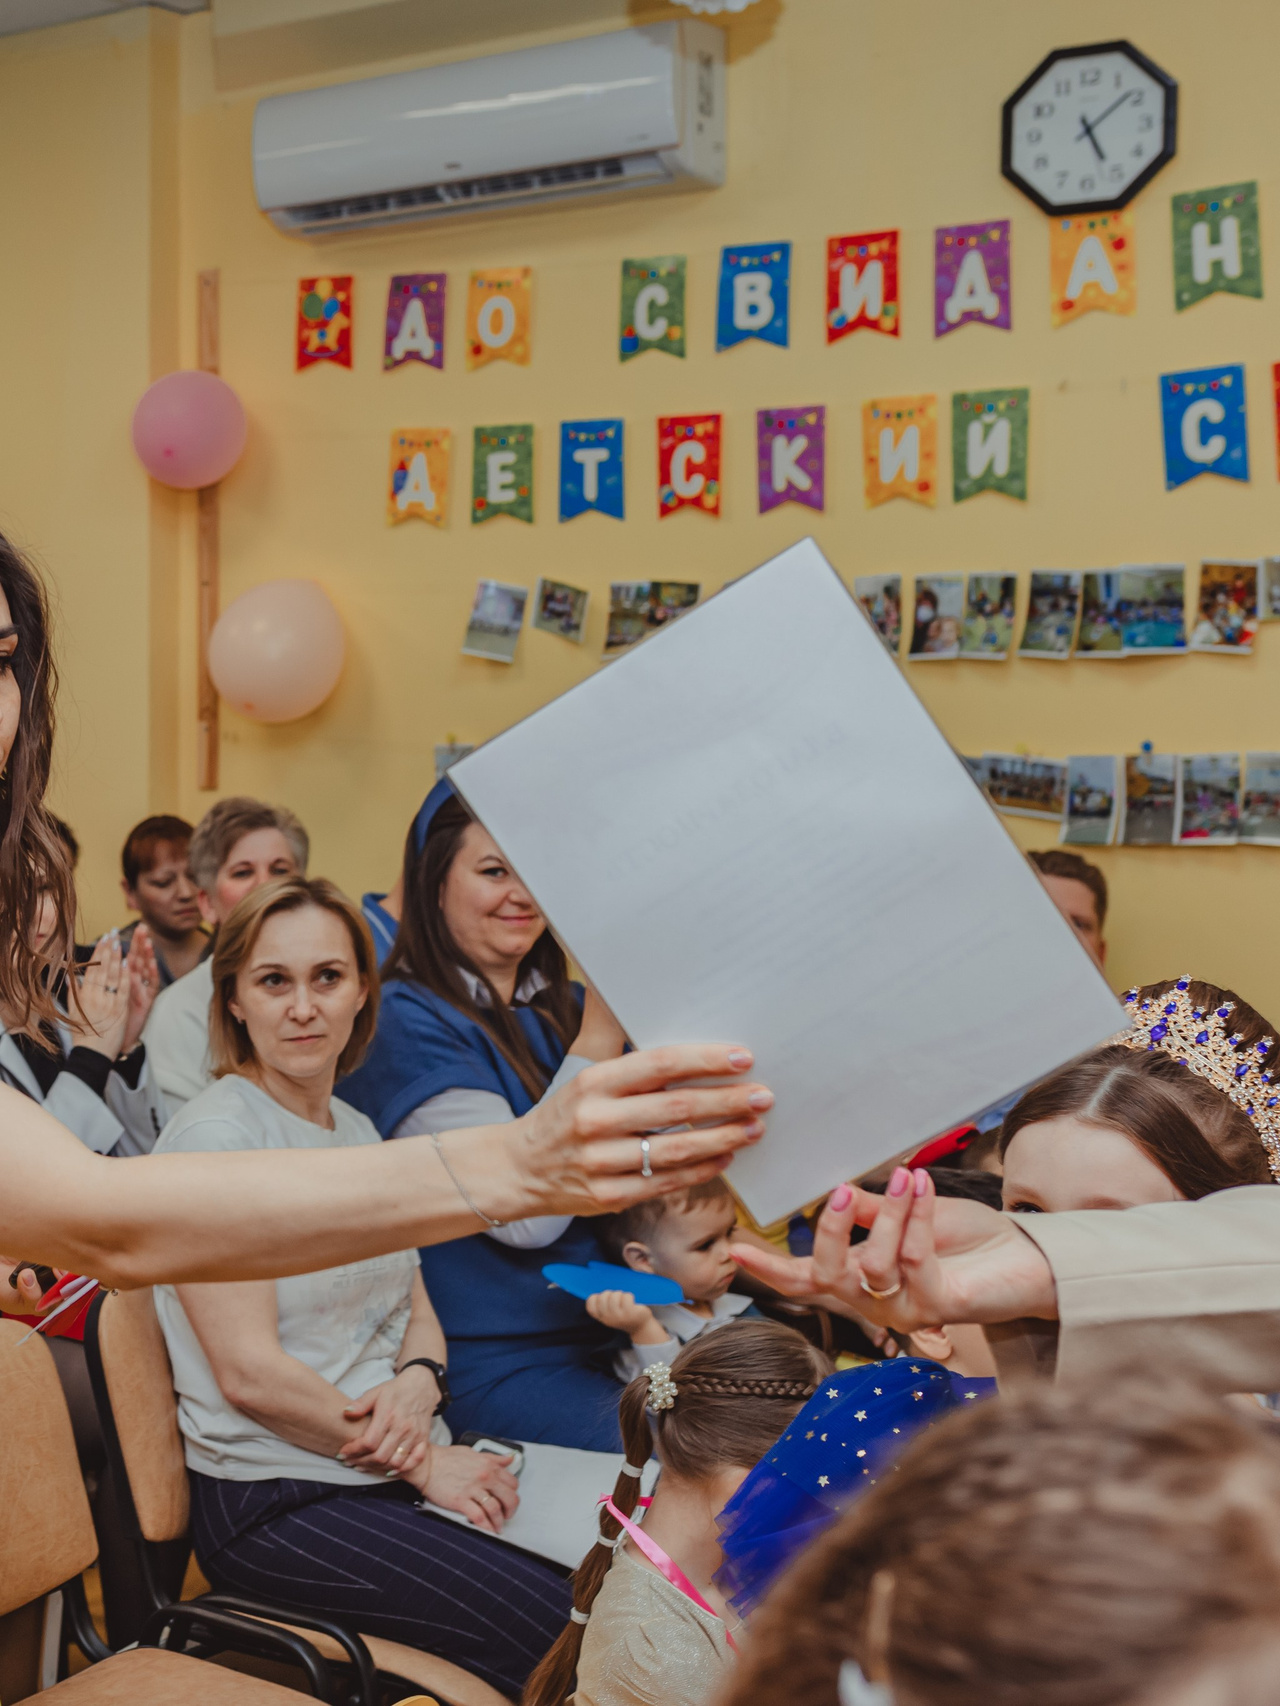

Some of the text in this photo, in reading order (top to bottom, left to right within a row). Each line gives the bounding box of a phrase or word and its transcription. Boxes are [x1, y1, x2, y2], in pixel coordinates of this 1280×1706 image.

[1079, 67, 1102, 88] 12
[1114, 70, 1122, 90] 1
[1054, 79, 1071, 98] 11
[1129, 88, 1145, 107] 2
[1033, 101, 1056, 120] 10
[1137, 114, 1153, 133] 3
[1026, 127, 1043, 145] 9
[1130, 143, 1144, 159] 4
[1033, 153, 1049, 171] 8
[1055, 169, 1070, 189] 7
[1108, 163, 1124, 183] 5
[1078, 174, 1096, 193] 6
[391, 296, 516, 361] ДО
[396, 412, 1011, 512] ДЕТСКИЙ
